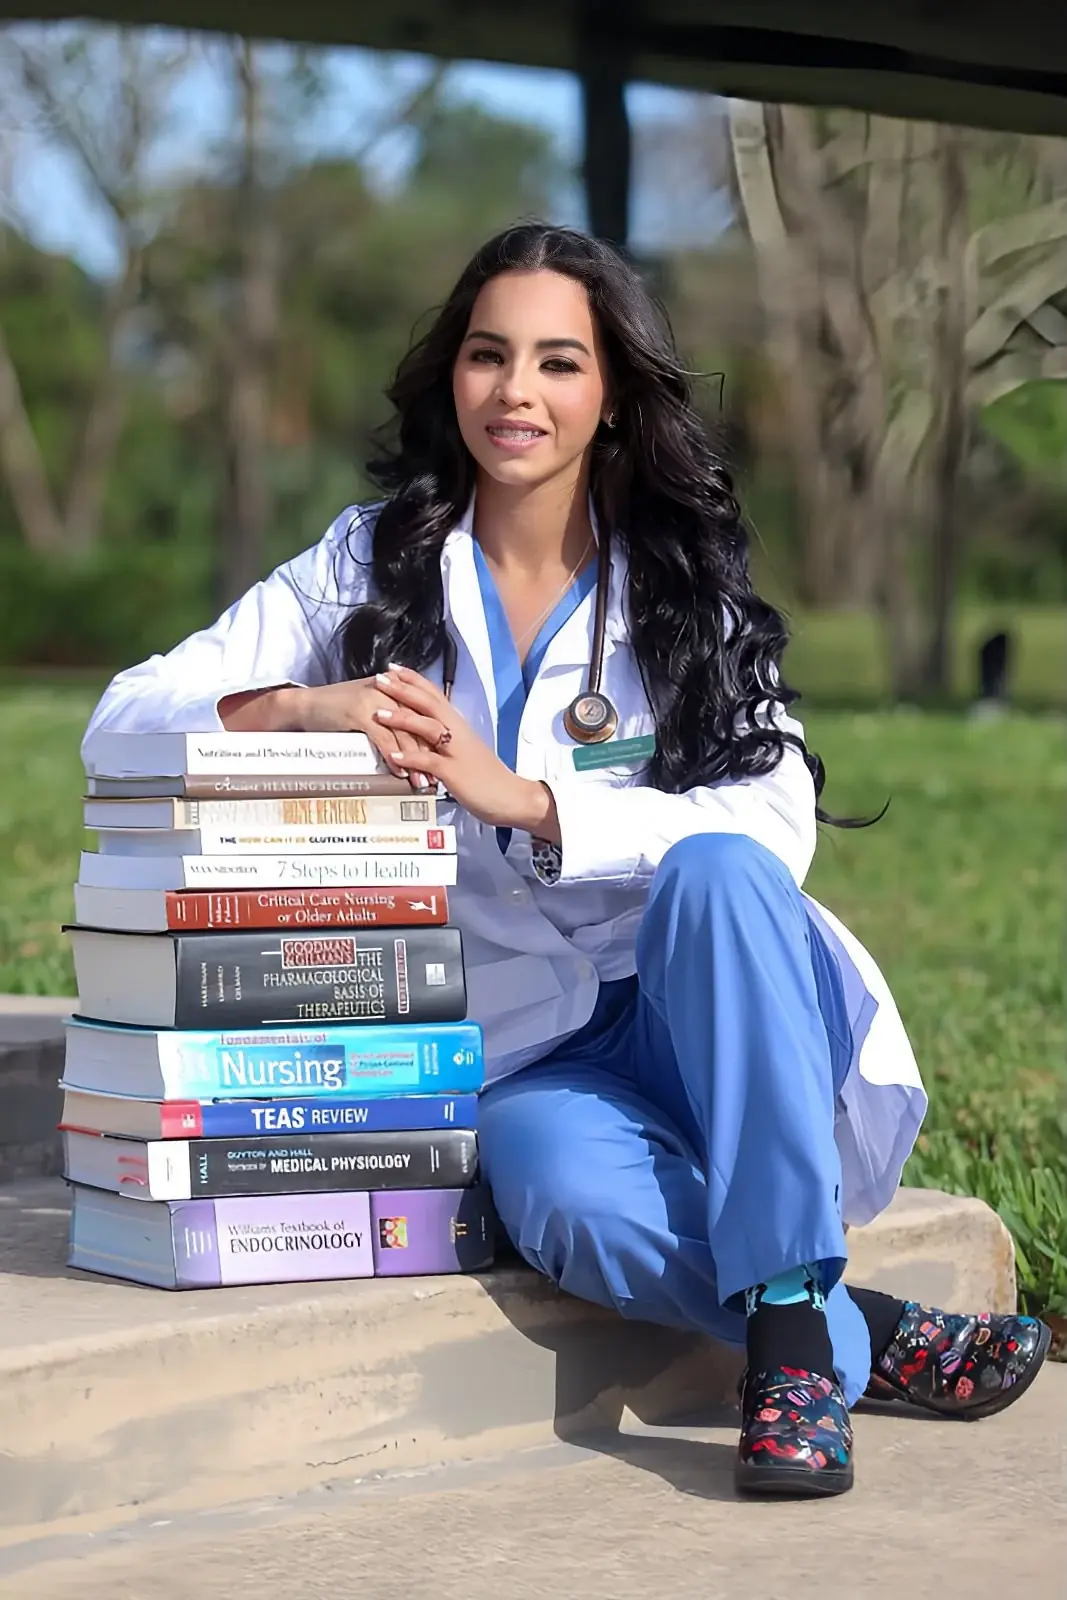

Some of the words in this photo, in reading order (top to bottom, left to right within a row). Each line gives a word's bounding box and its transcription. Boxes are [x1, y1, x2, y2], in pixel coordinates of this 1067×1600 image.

[263, 781, 316, 791] HEALING
[319, 781, 370, 791] SECRETS
[220, 836, 237, 844] THE
[309, 836, 345, 844] GLUTEN
[347, 836, 367, 844] FREE
[278, 862, 287, 877] 7
[291, 861, 339, 884] Steps
[343, 861, 360, 878] to
[364, 860, 420, 878] Health
[258, 892, 305, 907] Critical
[309, 892, 341, 906] Care
[344, 892, 395, 908] Nursing
[295, 909, 331, 922] Older
[336, 907, 376, 921] Adults
[284, 939, 350, 954] GOODMAN
[357, 952, 382, 966] THE
[263, 968, 383, 987] PHARMACOLOGICAL
[333, 987, 365, 1000] BASIS
[369, 985, 383, 998] OF
[297, 1003, 384, 1018] THERAPEUTICS
[221, 1050, 342, 1091] Nursing
[251, 1107, 305, 1130] TEAS
[312, 1108, 368, 1125] REVIEW
[268, 1150, 288, 1158] AND
[200, 1153, 208, 1184] HALL
[271, 1158, 328, 1173] MEDICAL
[331, 1154, 411, 1171] PHYSIOLOGY
[228, 1224, 276, 1236] Williams
[280, 1220, 330, 1233] Textbook
[334, 1220, 345, 1231] of
[230, 1232, 363, 1254] ENDOCRINOLOGY
